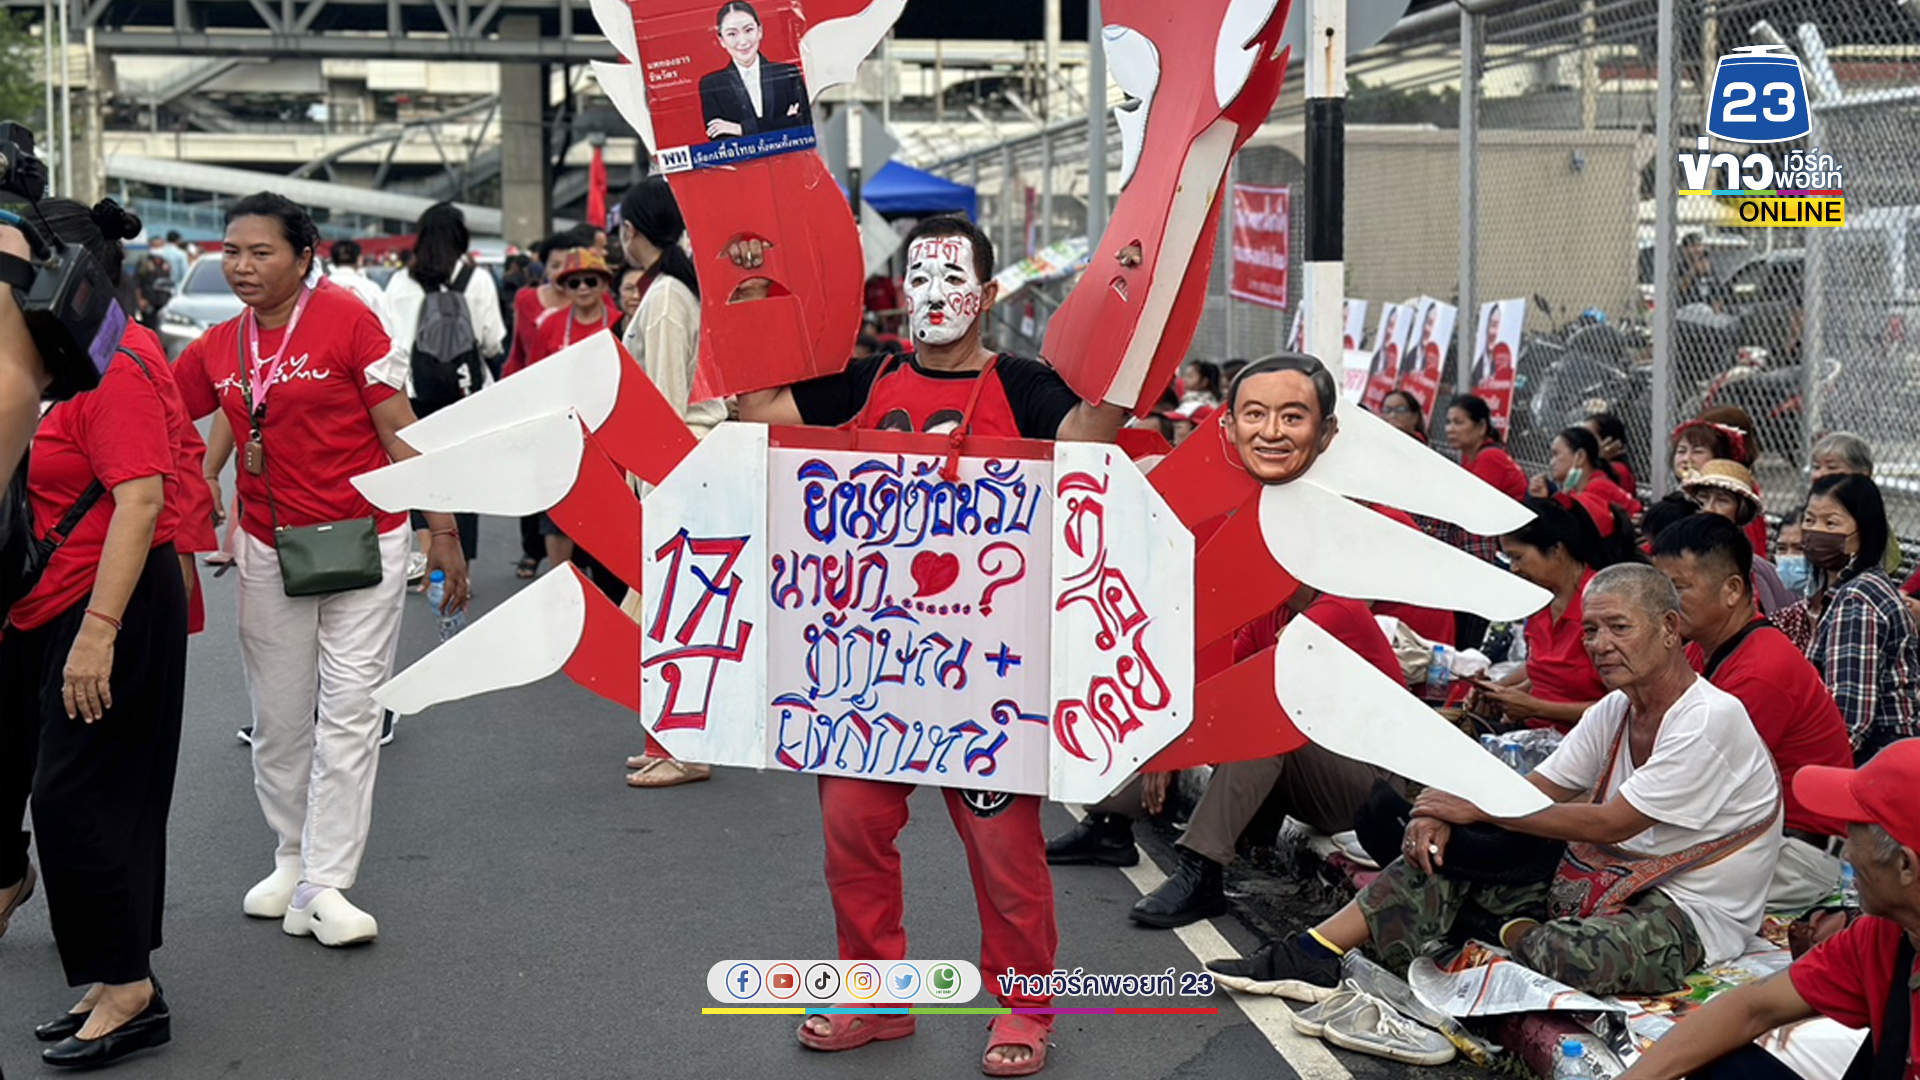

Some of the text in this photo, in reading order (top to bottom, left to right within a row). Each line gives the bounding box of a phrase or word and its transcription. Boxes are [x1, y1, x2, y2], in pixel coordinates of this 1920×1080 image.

[797, 454, 1041, 550] ยินดีต้อนรับ
[803, 605, 973, 698] ทักษิณ
